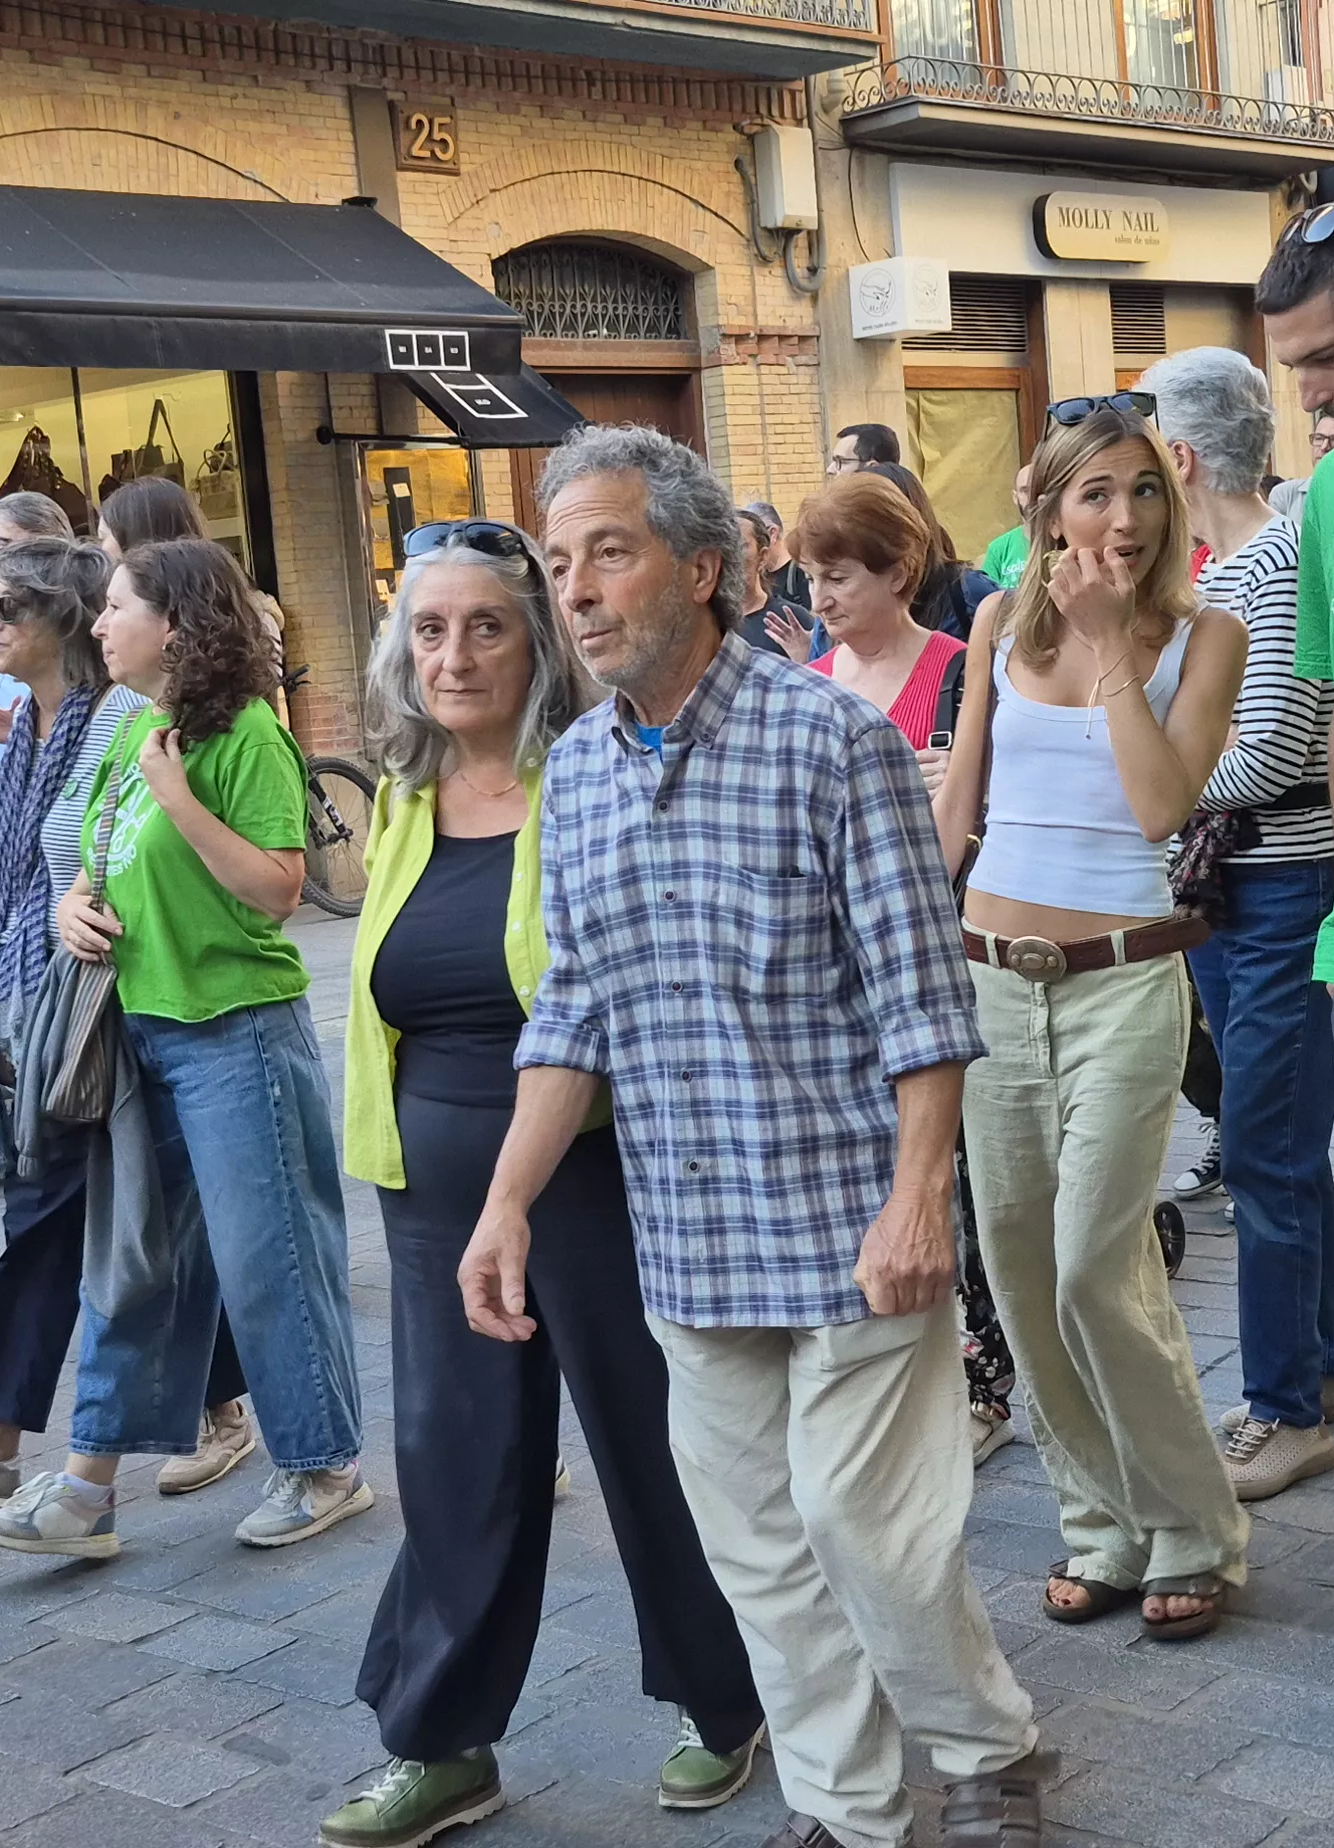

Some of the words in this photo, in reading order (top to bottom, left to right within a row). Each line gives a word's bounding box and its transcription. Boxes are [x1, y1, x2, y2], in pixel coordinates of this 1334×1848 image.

[410, 112, 455, 161] 25
[1057, 206, 1113, 230] MOLLY
[1122, 210, 1160, 233] NAIL
